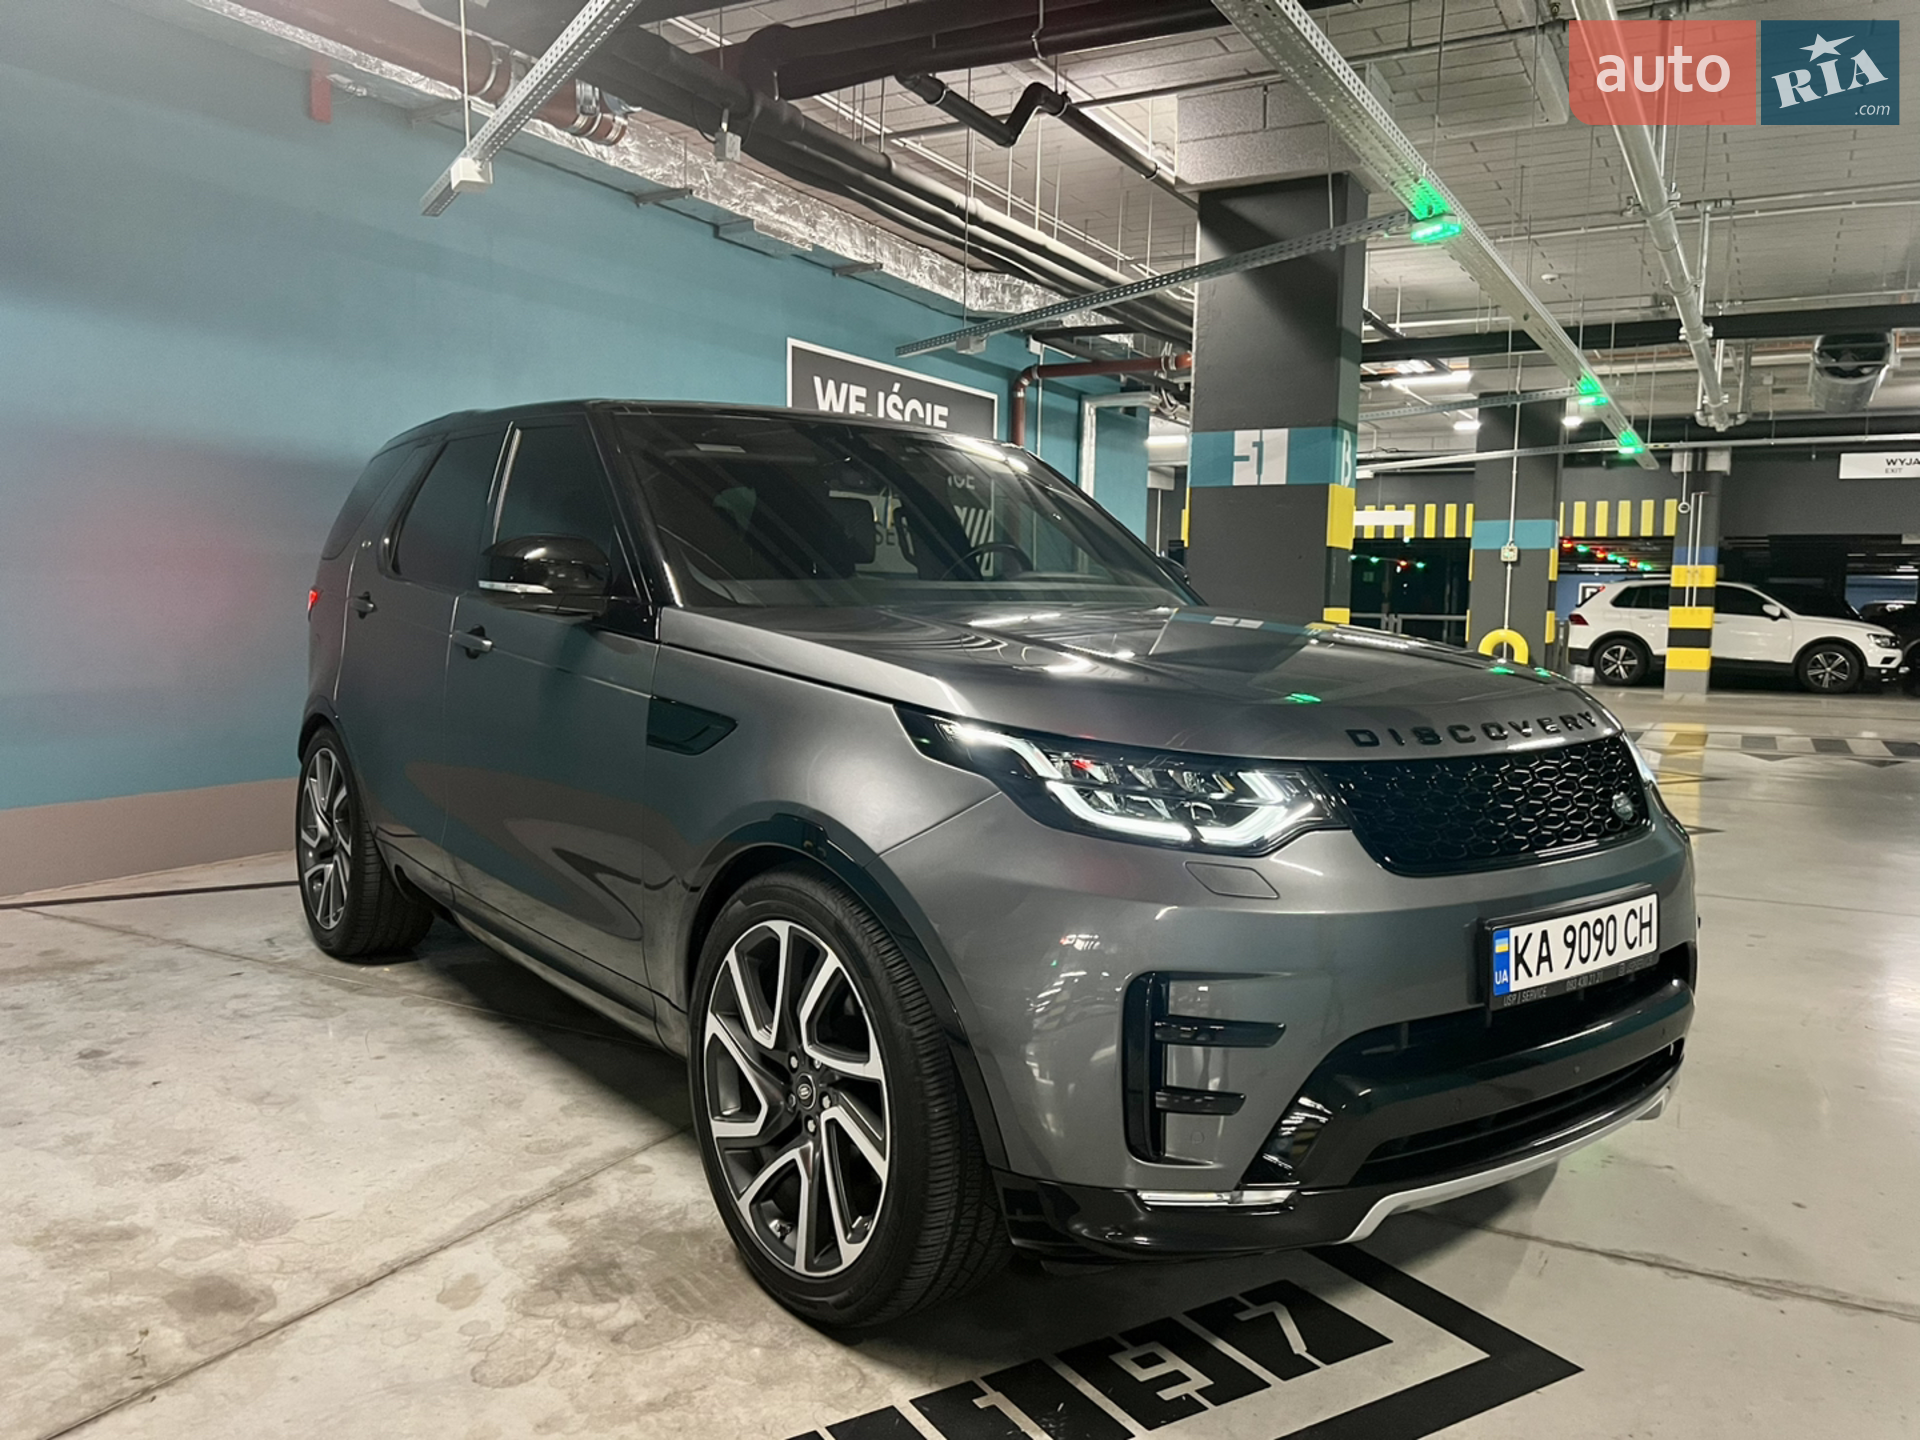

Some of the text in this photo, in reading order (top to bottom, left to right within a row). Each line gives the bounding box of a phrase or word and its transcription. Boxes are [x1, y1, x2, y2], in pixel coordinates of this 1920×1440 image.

[1345, 711, 1597, 747] DISCOVERY
[1514, 903, 1652, 981] KA 9090 CH
[1495, 969, 1509, 985] UA
